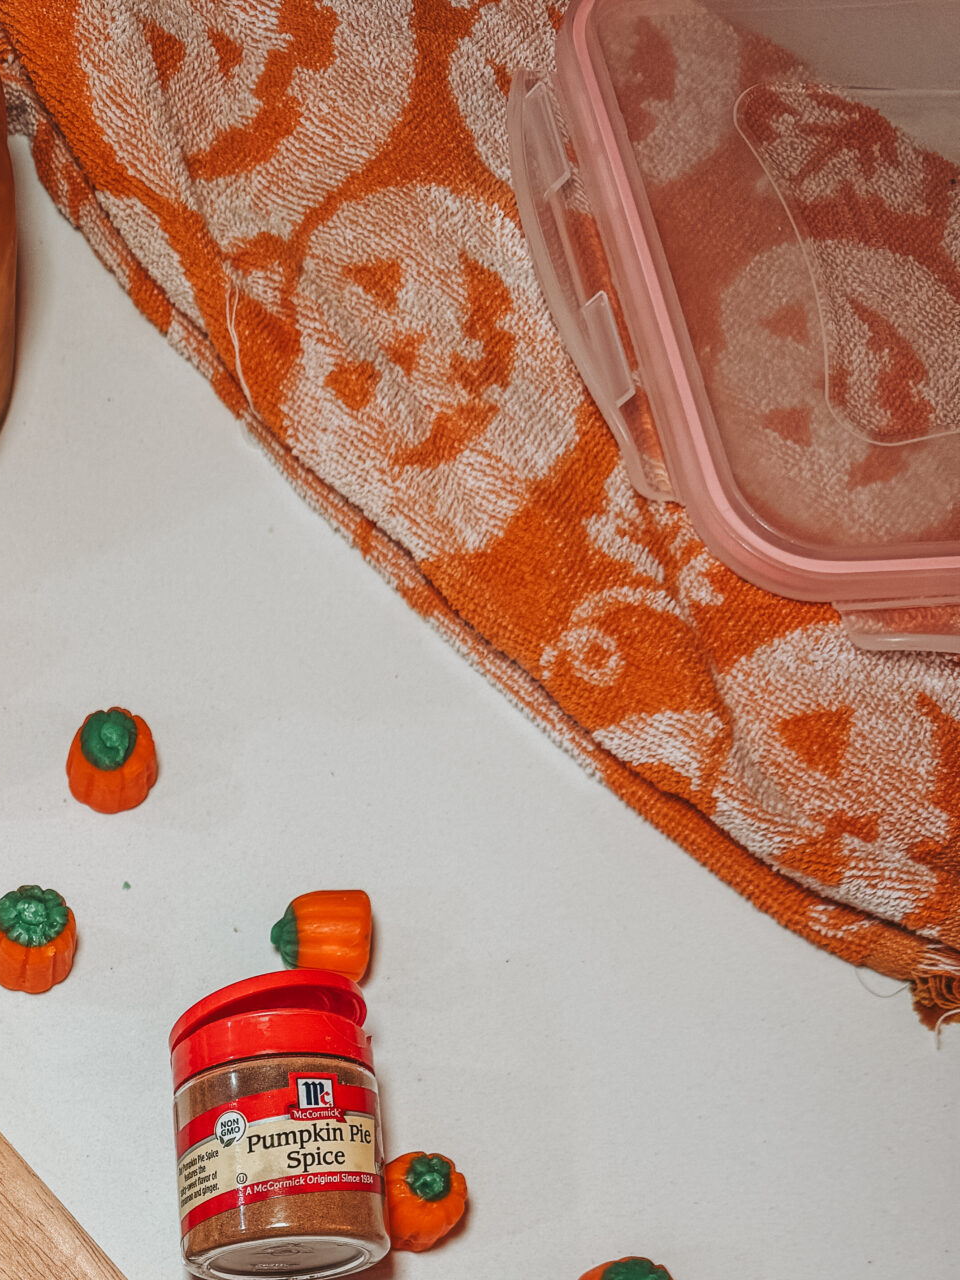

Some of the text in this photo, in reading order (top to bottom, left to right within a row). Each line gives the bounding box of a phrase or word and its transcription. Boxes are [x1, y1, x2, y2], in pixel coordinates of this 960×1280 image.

[220, 1118, 240, 1130] NON
[220, 1126, 241, 1137] GMO
[247, 1122, 372, 1154] Pumpkin Pie
[205, 1150, 219, 1160] Spice
[286, 1147, 346, 1172] Spice
[245, 1173, 374, 1196] A McCormick Original Since 1934
